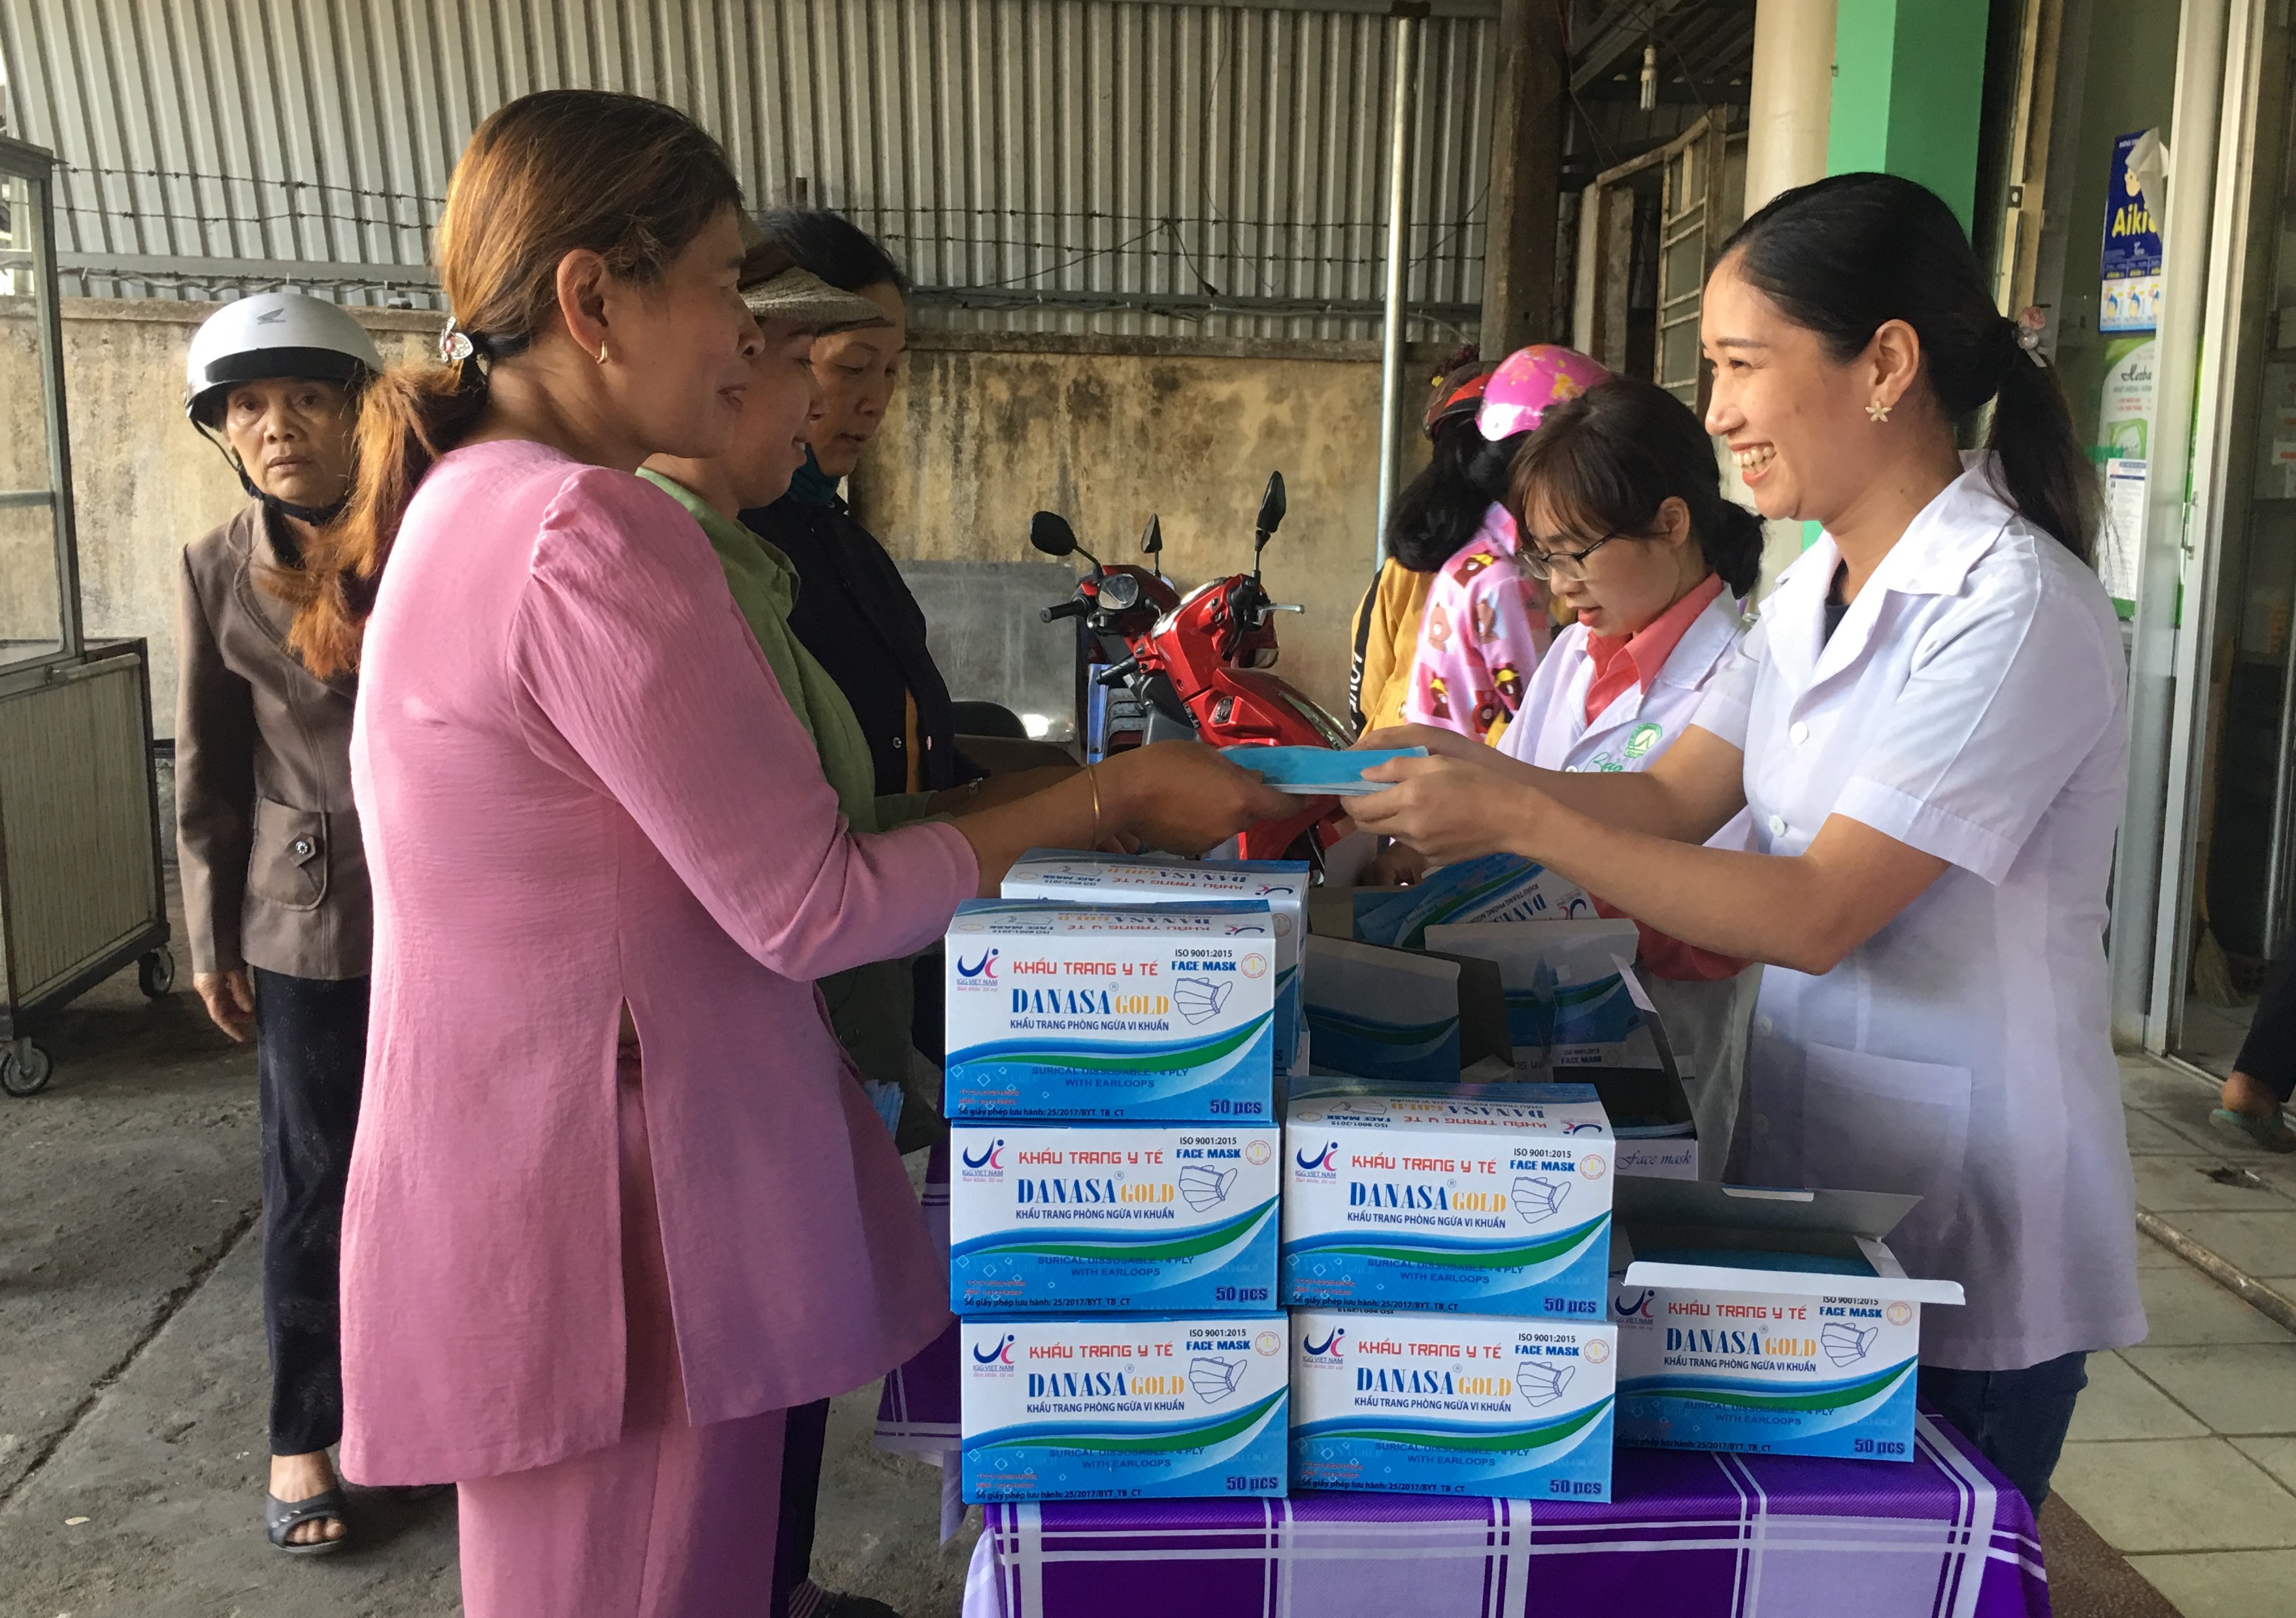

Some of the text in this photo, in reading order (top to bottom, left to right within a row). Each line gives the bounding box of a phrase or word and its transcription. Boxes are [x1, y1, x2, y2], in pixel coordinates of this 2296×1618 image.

[1190, 949, 1232, 957] 9001:2015
[1063, 962, 1116, 975] TRANG
[1122, 963, 1133, 975] Y
[1139, 959, 1157, 976] TẾ
[1171, 961, 1236, 970] FACE MASK
[1011, 988, 1169, 1015] DANASA GOLD
[1036, 1020, 1065, 1029] TRANG
[1067, 1019, 1099, 1030] PHÒNG
[1127, 1021, 1136, 1030] VI
[1065, 1078, 1154, 1088] WITH EARLOOPS
[1210, 1099, 1262, 1116] 50 pcs
[1448, 1104, 1545, 1118] DANASA
[1445, 1117, 1497, 1126] TRANG
[1069, 1151, 1121, 1164] TRANG
[1127, 1151, 1137, 1164] Y
[1144, 1147, 1163, 1164] TẾ
[1176, 1149, 1240, 1158] FACE MASK
[1514, 1147, 1571, 1158] ISO 9001:2015
[1401, 1157, 1454, 1172] TRANG
[1460, 1160, 1471, 1172] Y
[1477, 1157, 1496, 1174] TẾ
[1510, 1159, 1575, 1172] FACE MASK
[1614, 1150, 1692, 1170] Face mask
[1016, 1178, 1174, 1203] DANASA GOLD
[1348, 1181, 1506, 1213] DANASA GOLD
[1042, 1210, 1071, 1219] TRANG
[1073, 1208, 1104, 1219] PHÒNG
[1133, 1210, 1141, 1219] VI
[1373, 1213, 1402, 1223] TRANG
[1404, 1213, 1435, 1225] PHÒNG
[1464, 1217, 1472, 1227] VI
[1400, 1272, 1489, 1283] WITH EARLOOPS
[1216, 1287, 1267, 1302] 50 pcs
[1544, 1297, 1597, 1315] 50 pcs
[1716, 1304, 1767, 1318] TRANG
[1772, 1307, 1782, 1319] Y
[1788, 1304, 1806, 1320] TẾ
[1820, 1306, 1882, 1317] FACE MASK
[1186, 1340, 1250, 1350] FACE MASK
[1534, 1334, 1576, 1343] 9001:2015
[1665, 1327, 1816, 1357] DANASA GOLD
[1079, 1345, 1131, 1358] TRANG
[1137, 1344, 1148, 1357] Y
[1154, 1340, 1173, 1357] TẾ
[1408, 1343, 1460, 1357] TRANG
[1466, 1346, 1476, 1358] Y
[1482, 1342, 1501, 1359] TẾ
[1514, 1344, 1580, 1356] FACE MASK
[1027, 1372, 1184, 1397] DANASA GOLD
[1356, 1367, 1511, 1396] DANASA GOLD
[1052, 1403, 1082, 1412] TRANG
[1084, 1401, 1114, 1412] PHÒNG
[1144, 1402, 1152, 1411] VI
[1380, 1398, 1408, 1408] TRANG
[1410, 1398, 1441, 1409] PHÒNG
[1470, 1402, 1478, 1410] VI
[1716, 1413, 1801, 1425] WITH EARLOOPS
[1854, 1438, 1905, 1456] 50 pcs
[1112, 1459, 1171, 1468] EARLOOPS
[1407, 1455, 1495, 1466] WITH EARLOOPS
[1226, 1476, 1278, 1491] 50 pcs
[1549, 1479, 1602, 1496] 50 pcs
